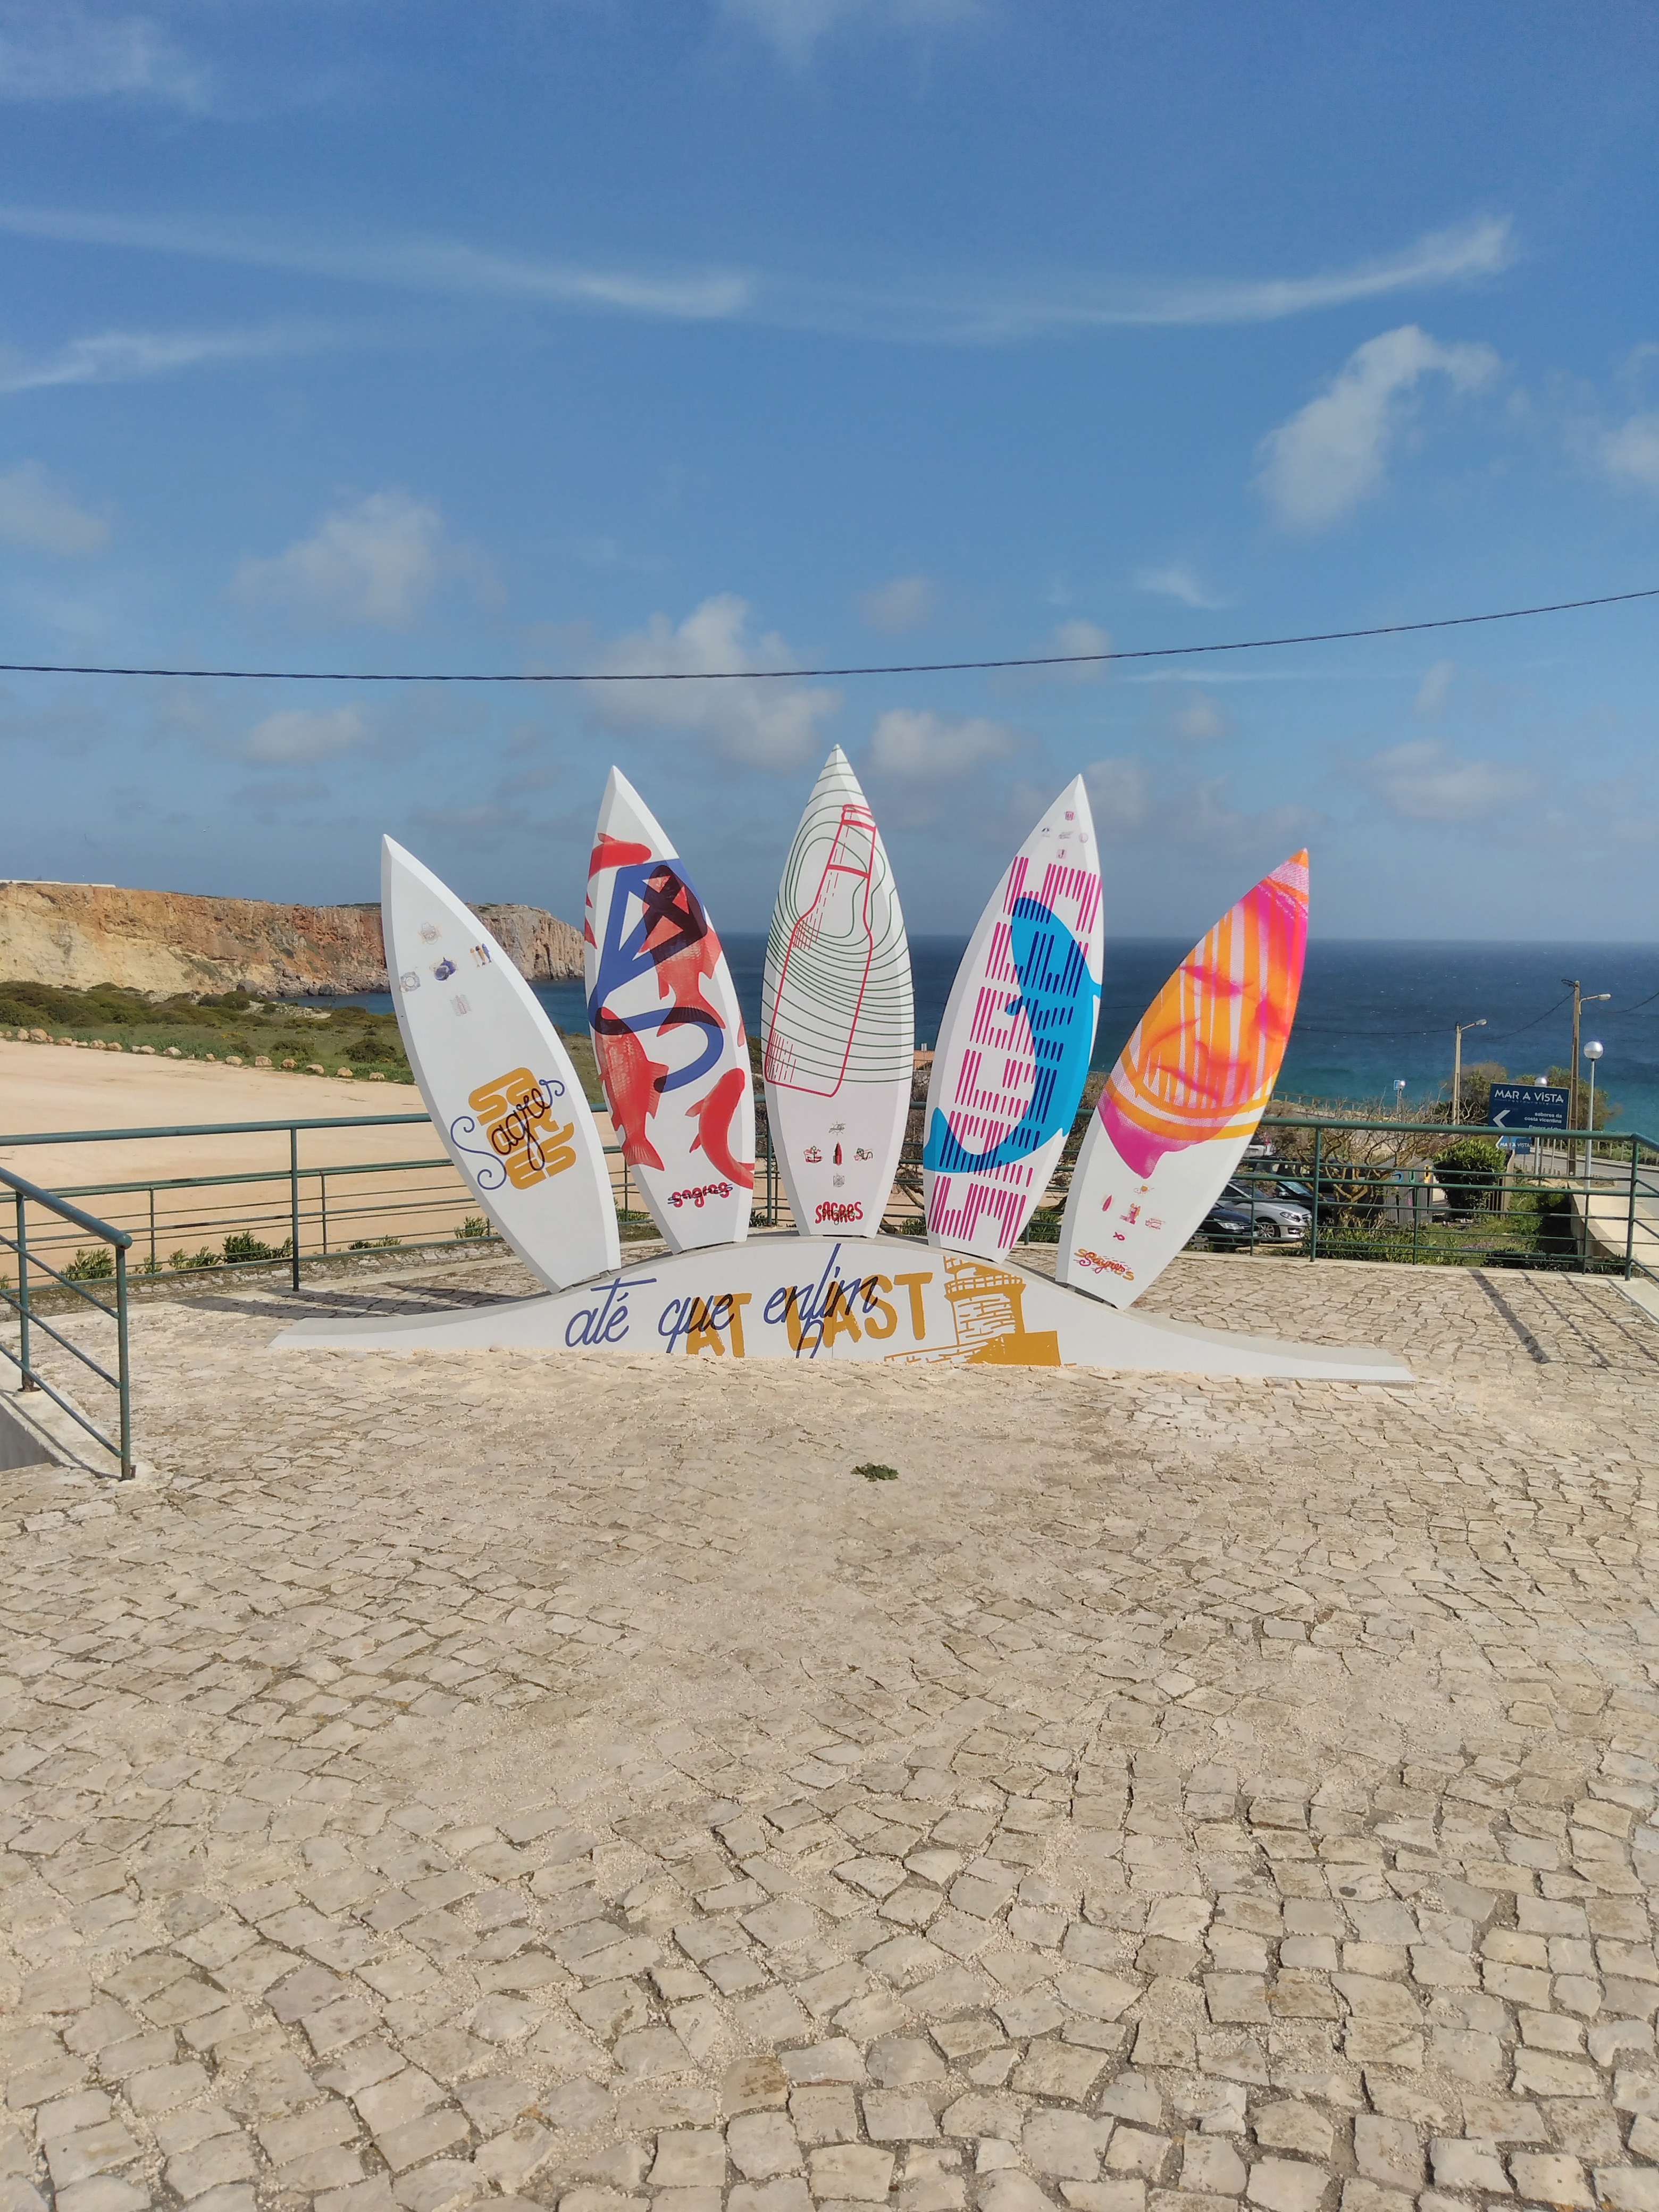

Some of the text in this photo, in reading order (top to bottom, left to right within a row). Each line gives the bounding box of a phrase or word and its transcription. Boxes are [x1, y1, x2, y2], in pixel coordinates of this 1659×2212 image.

[1494, 1090, 1520, 1099] MAR
[1522, 1092, 1531, 1101] A
[565, 1277, 657, 1347] até
[658, 1293, 735, 1353] que
[686, 1272, 933, 1358] AT LAST
